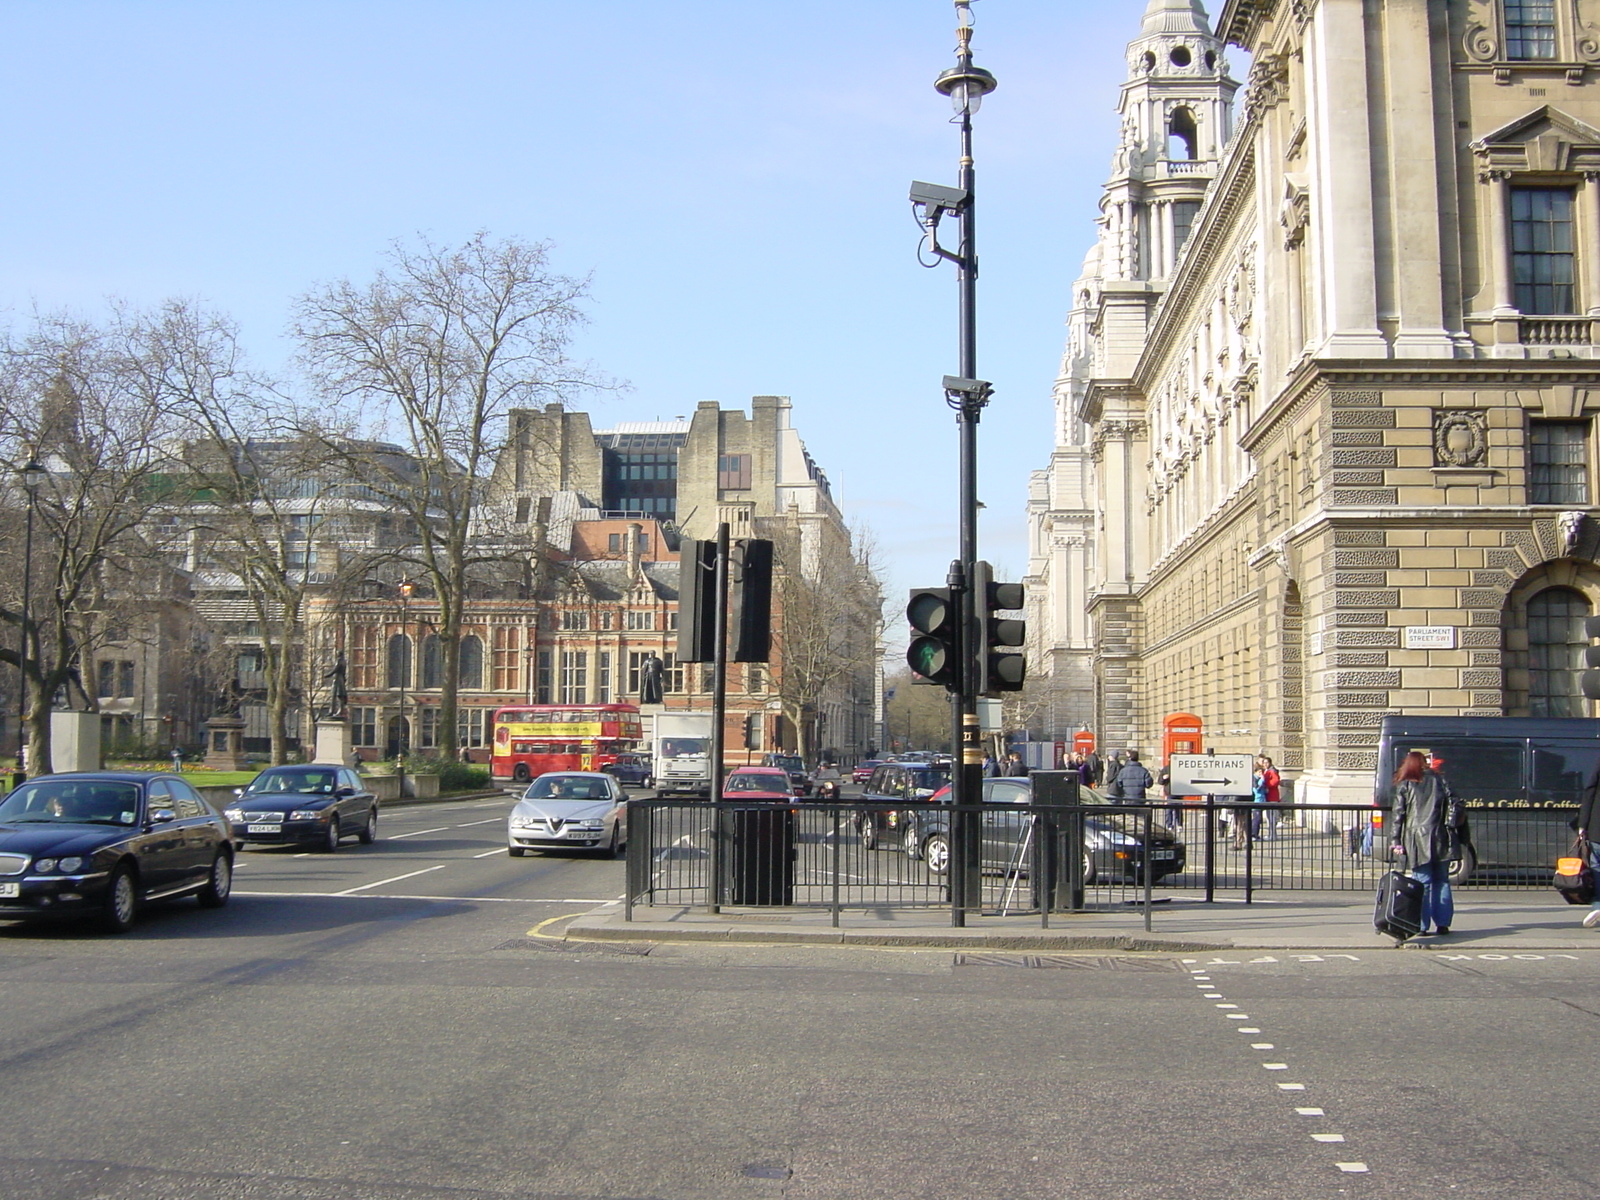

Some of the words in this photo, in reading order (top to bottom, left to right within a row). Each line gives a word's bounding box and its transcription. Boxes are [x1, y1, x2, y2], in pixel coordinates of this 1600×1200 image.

[1178, 759, 1245, 769] PEDESTRIANS
[1461, 797, 1484, 808] afé
[1206, 953, 1360, 965] LEFT
[1437, 952, 1579, 962] LOOK
